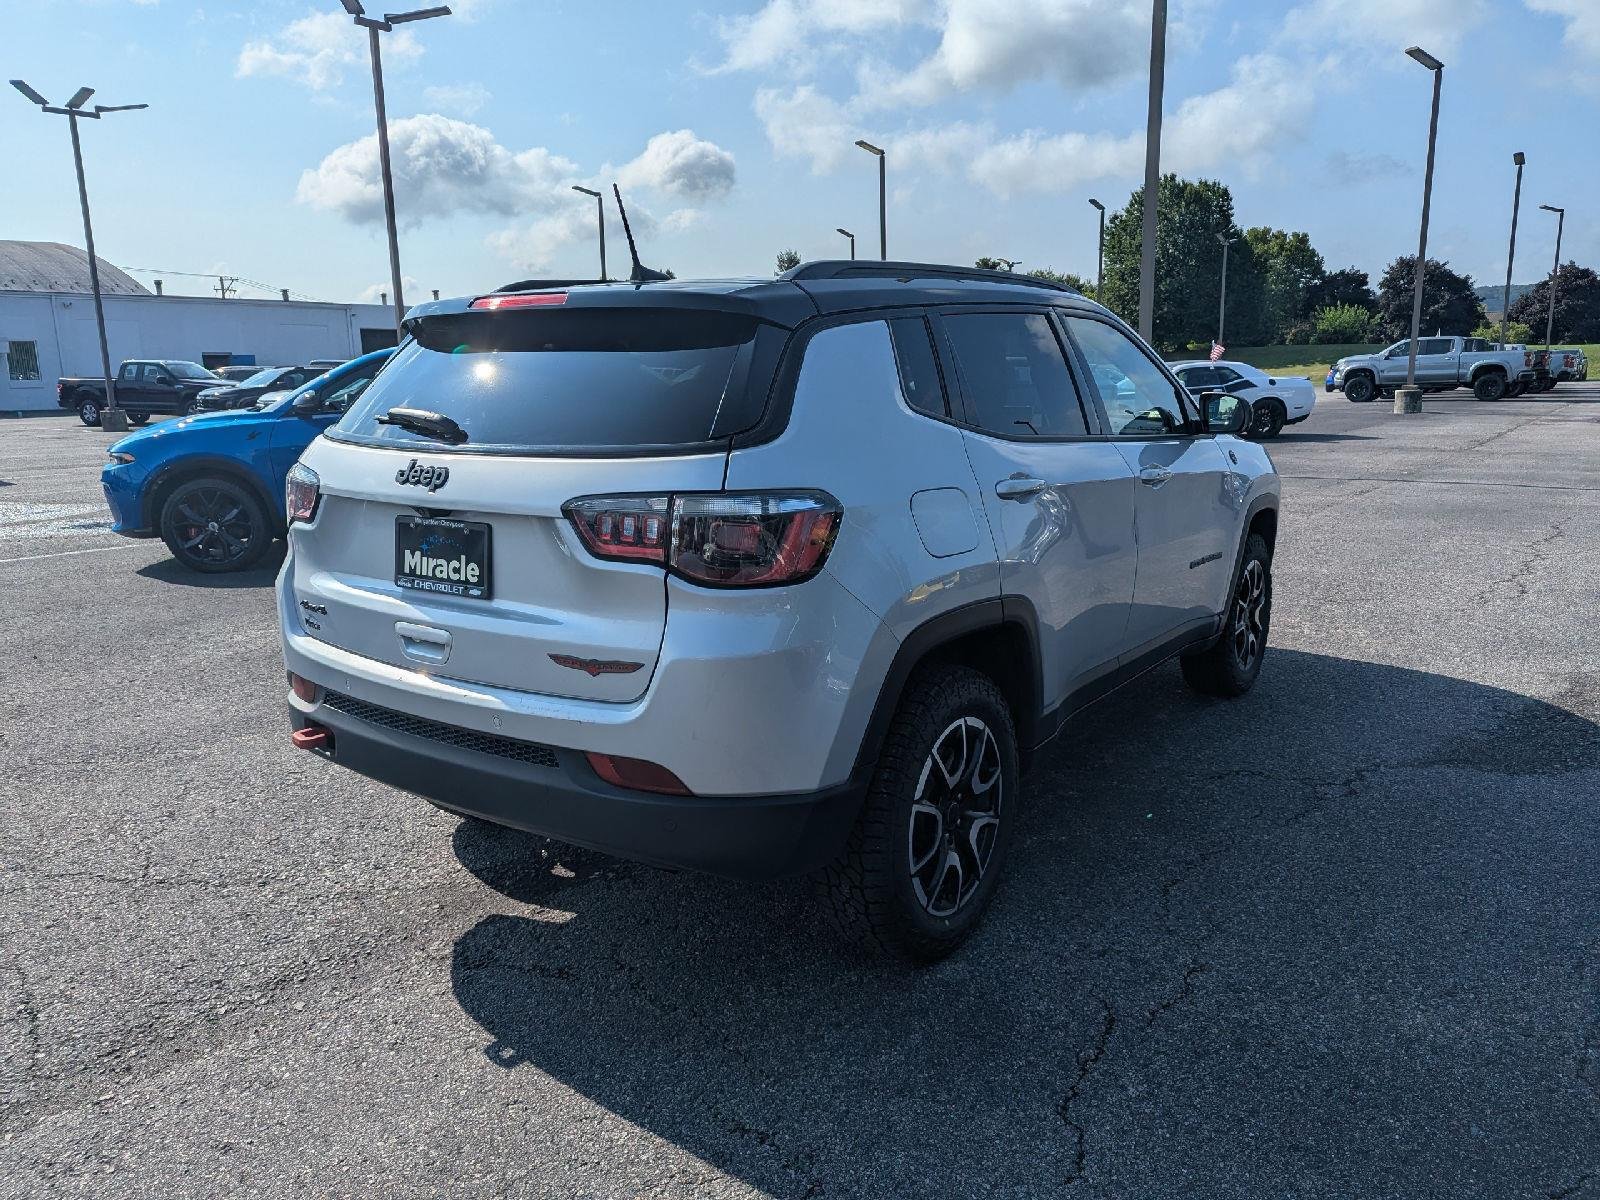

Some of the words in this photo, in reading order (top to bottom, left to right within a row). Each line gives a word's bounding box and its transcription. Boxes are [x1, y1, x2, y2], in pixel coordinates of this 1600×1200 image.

[395, 459, 450, 494] Jeep
[403, 549, 480, 583] Miracle
[414, 580, 465, 595] CHEVROLET
